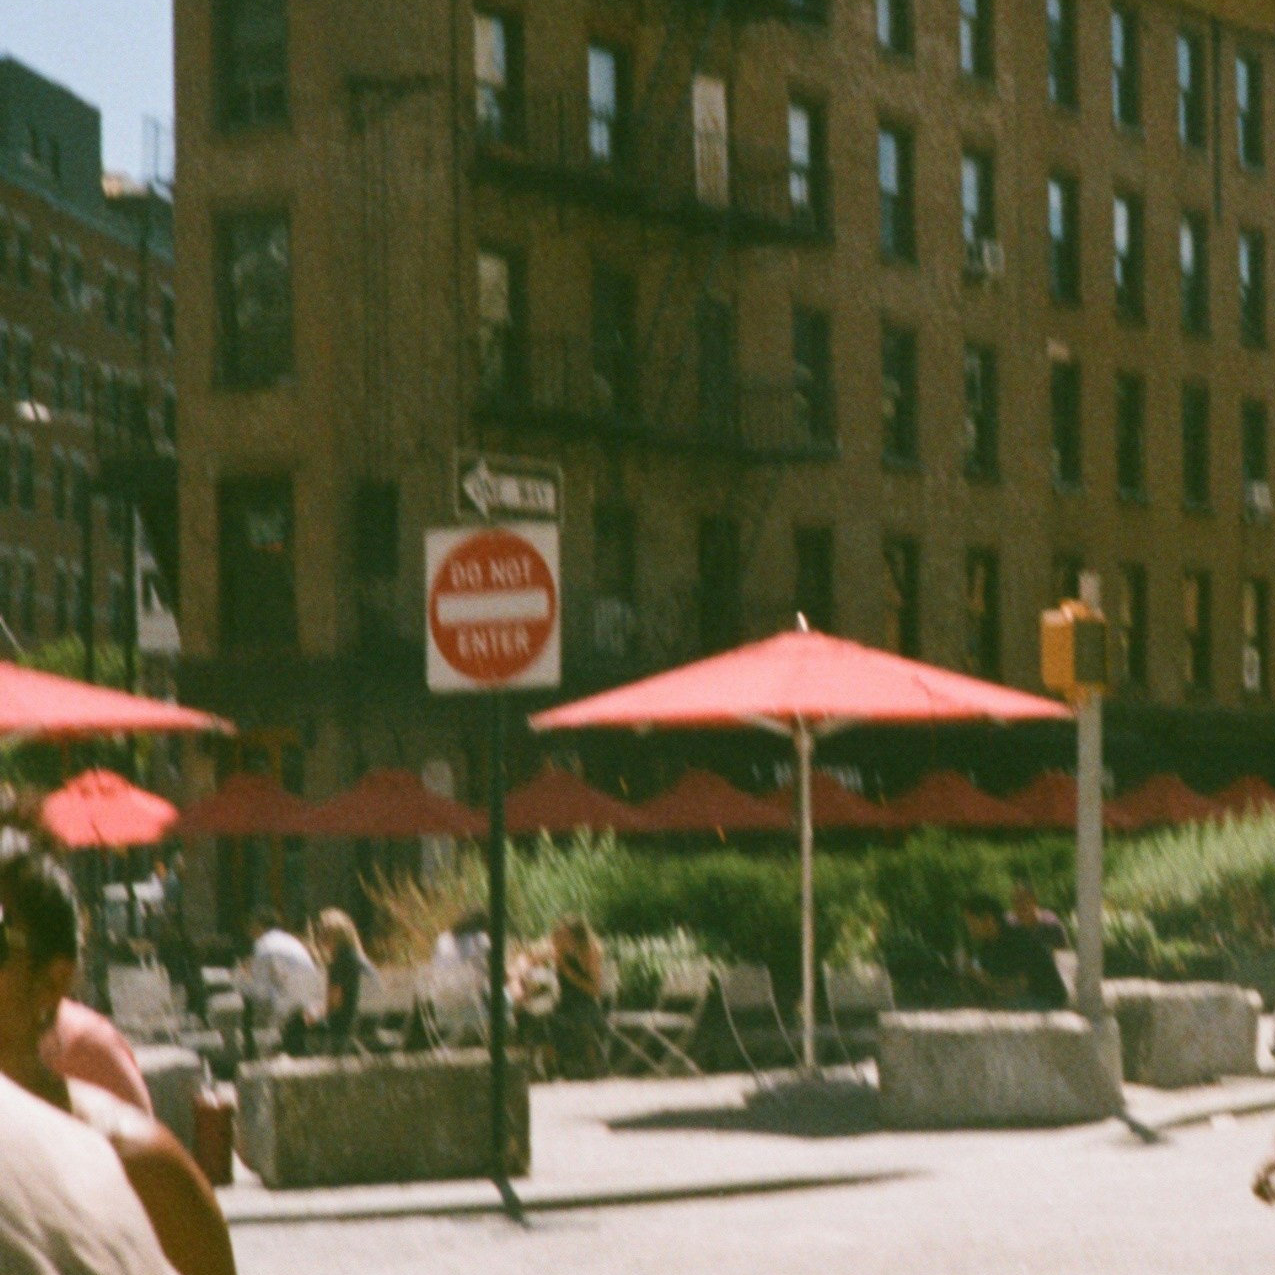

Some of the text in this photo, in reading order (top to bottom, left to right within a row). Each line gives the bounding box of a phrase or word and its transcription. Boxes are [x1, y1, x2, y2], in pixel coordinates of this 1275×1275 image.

[451, 554, 531, 590] DO NOT
[457, 624, 530, 658] ENTER
